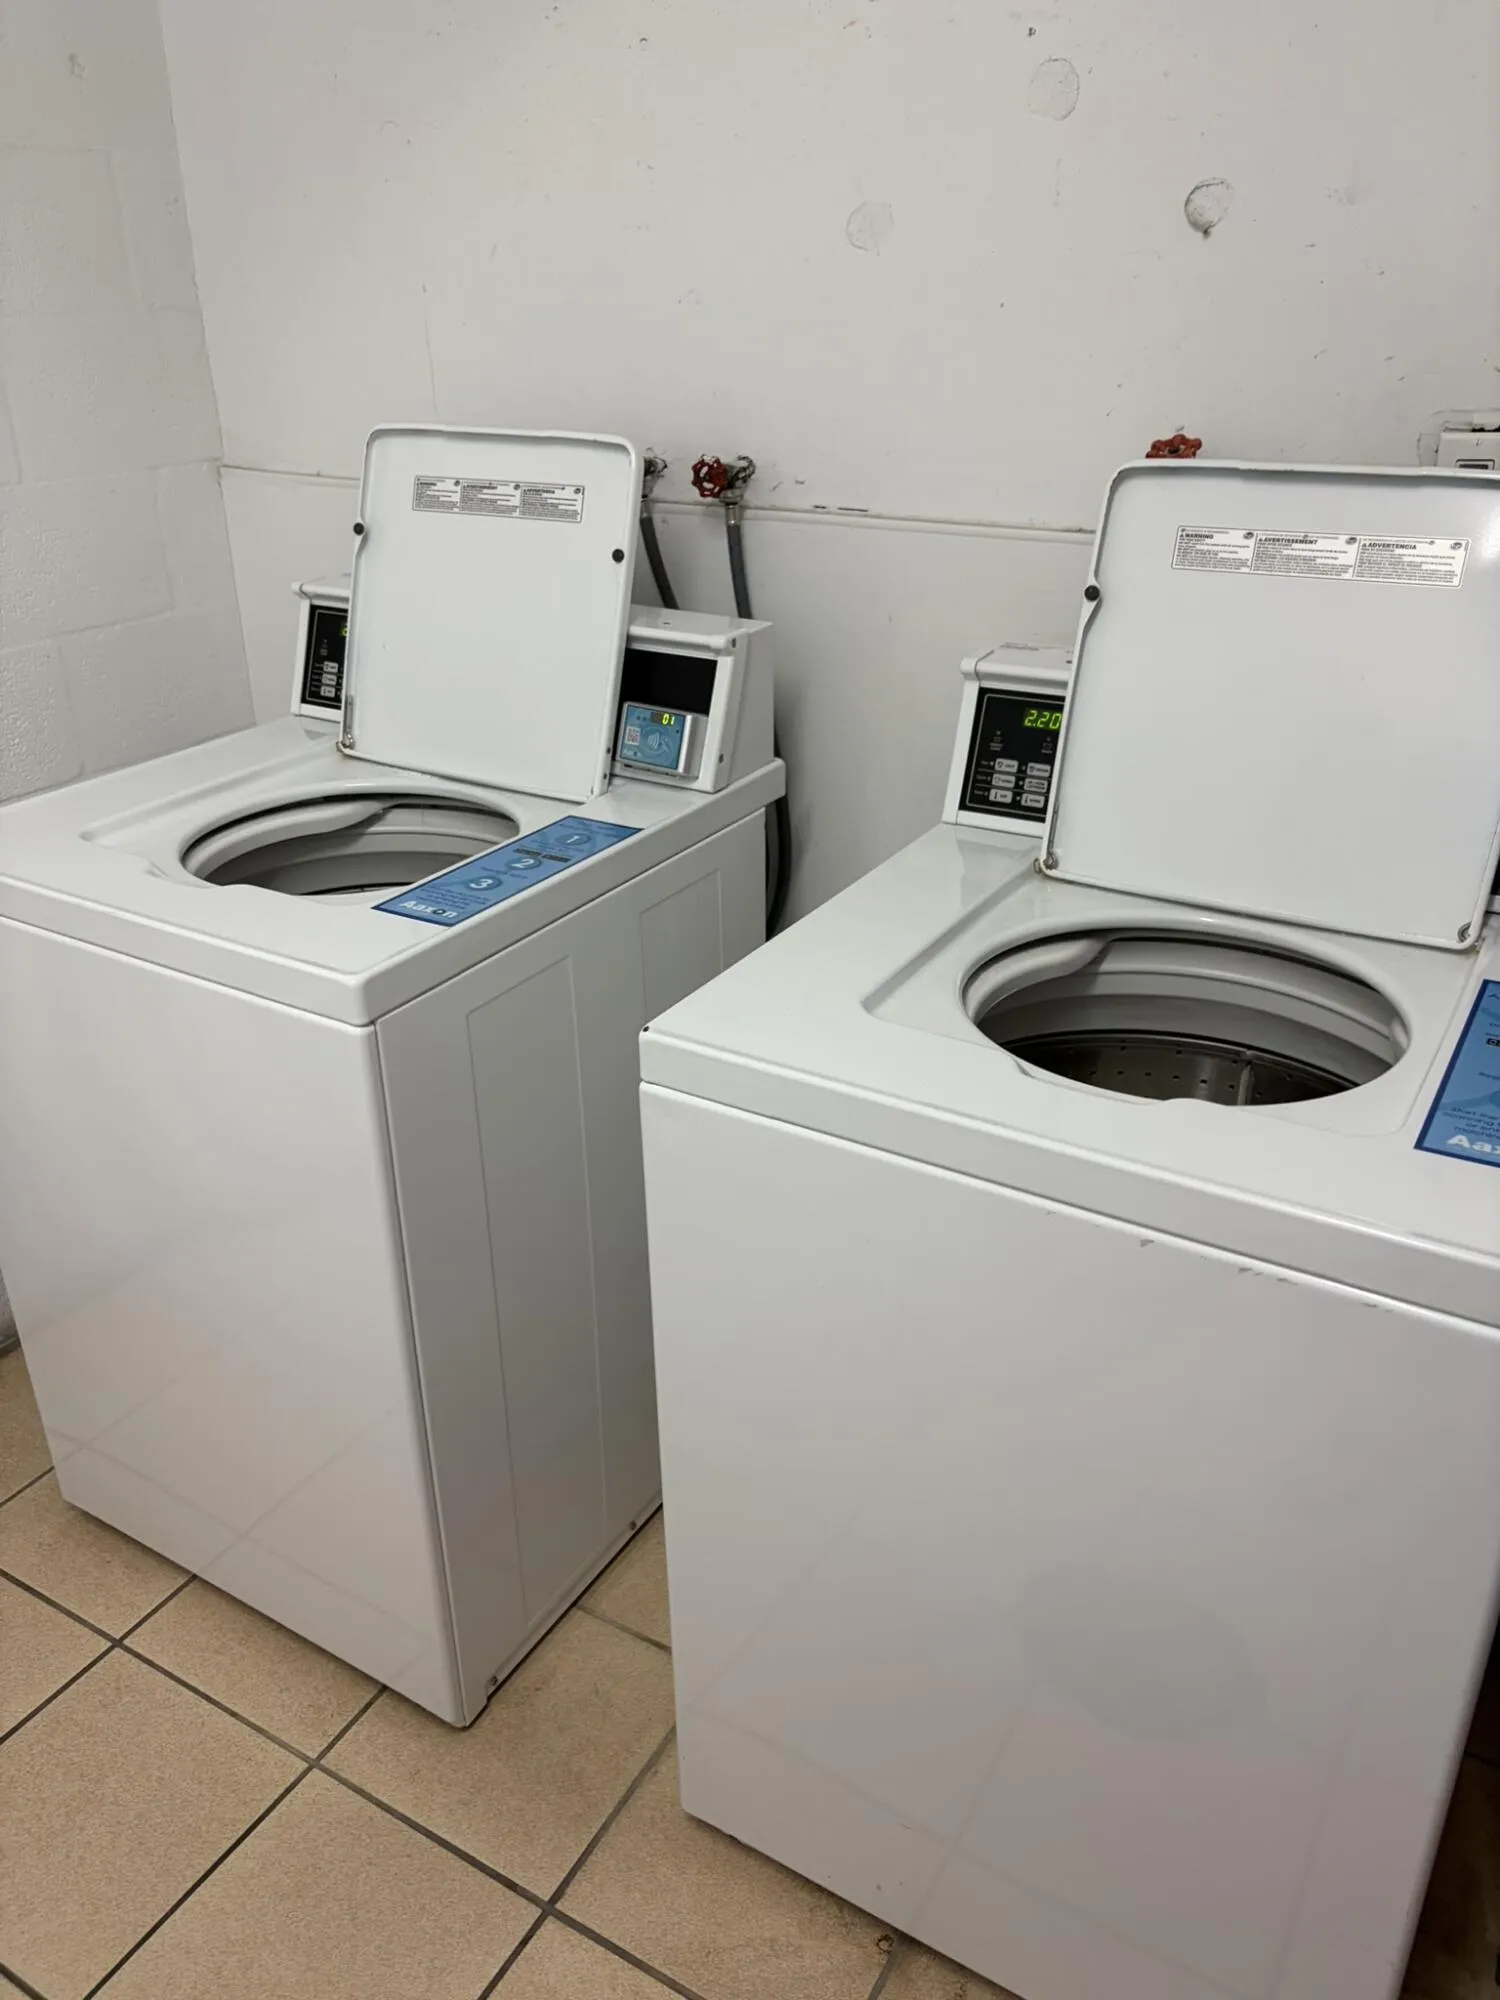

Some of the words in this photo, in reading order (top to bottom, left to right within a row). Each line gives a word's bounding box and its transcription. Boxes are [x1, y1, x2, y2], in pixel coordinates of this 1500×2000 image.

[1184, 532, 1214, 540] WARNING
[1263, 537, 1318, 545] AVERTISSEMENT
[1367, 542, 1417, 550] ADVERTENCIA
[662, 713, 675, 726] 01
[1024, 709, 1062, 729] 2.20
[511, 858, 535, 869] 2
[469, 876, 494, 889] 3
[400, 900, 458, 918] Aaxon
